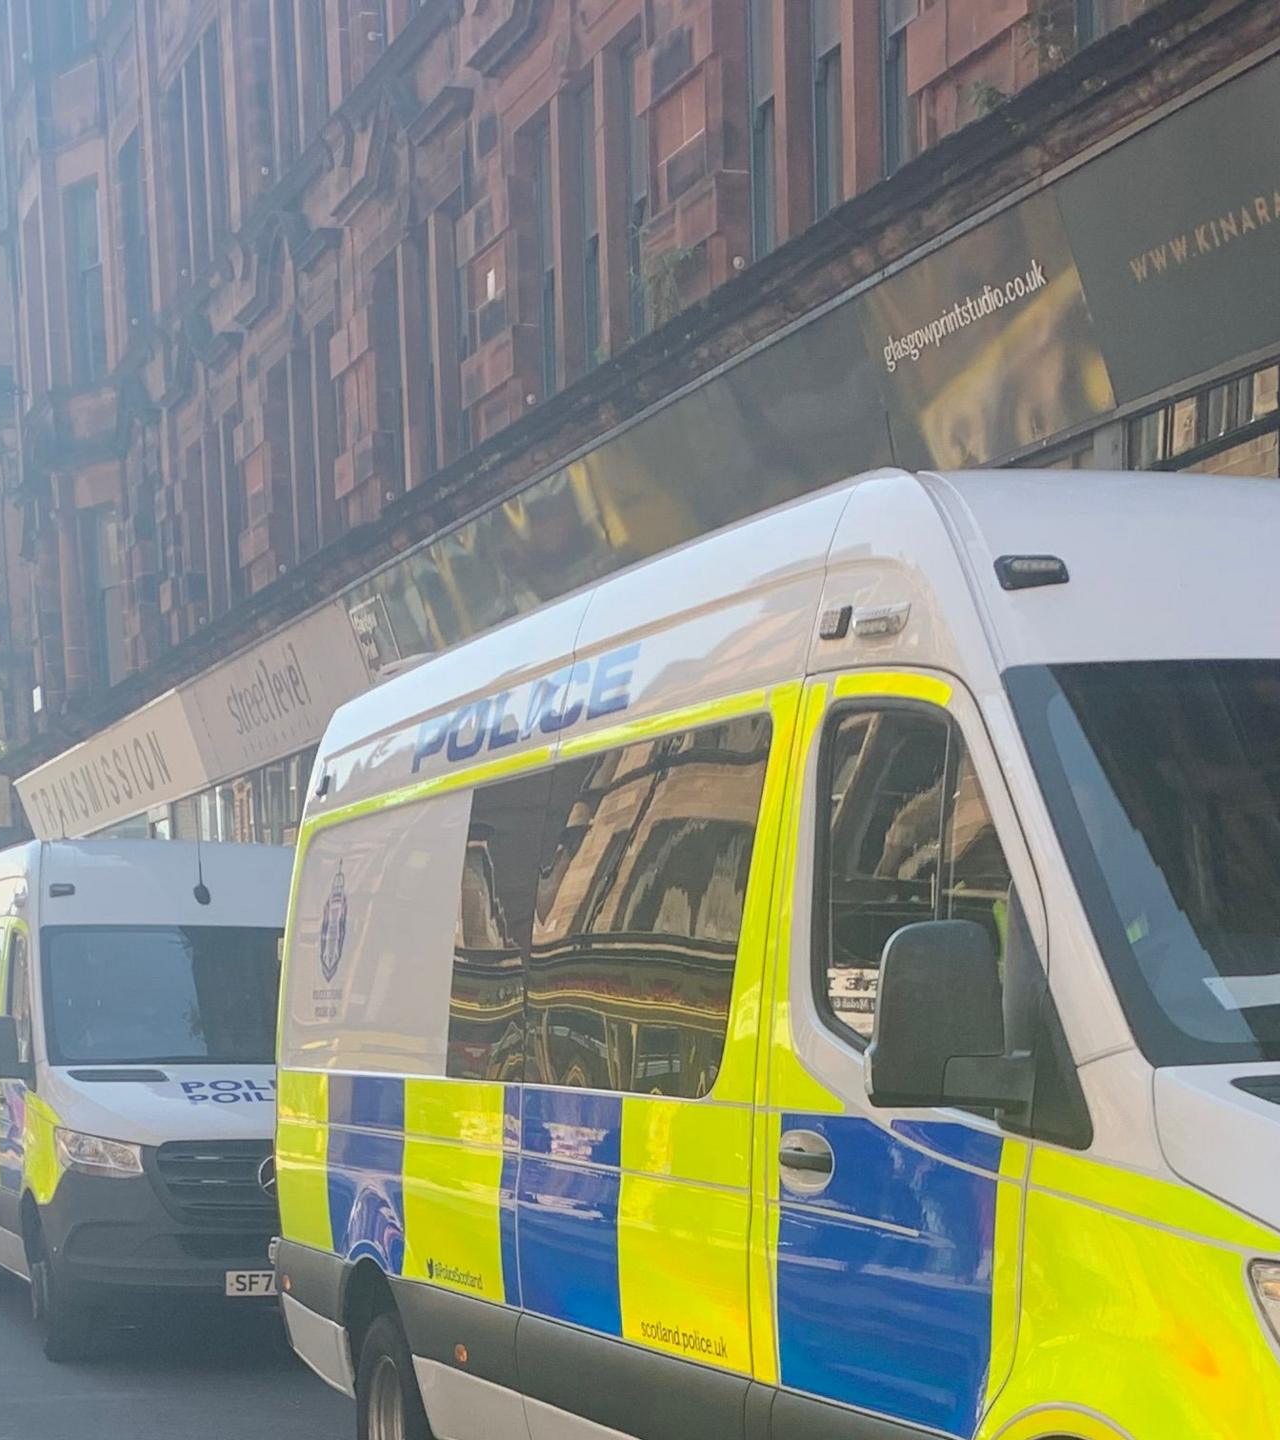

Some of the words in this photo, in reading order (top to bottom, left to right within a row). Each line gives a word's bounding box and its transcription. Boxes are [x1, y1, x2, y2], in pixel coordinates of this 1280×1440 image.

[883, 259, 1047, 372] glasgowprintstudio.co.uk
[411, 643, 641, 774] POLICE
[30, 730, 172, 835] TRANSMISSION
[641, 1320, 728, 1358] scotland.police.uk
